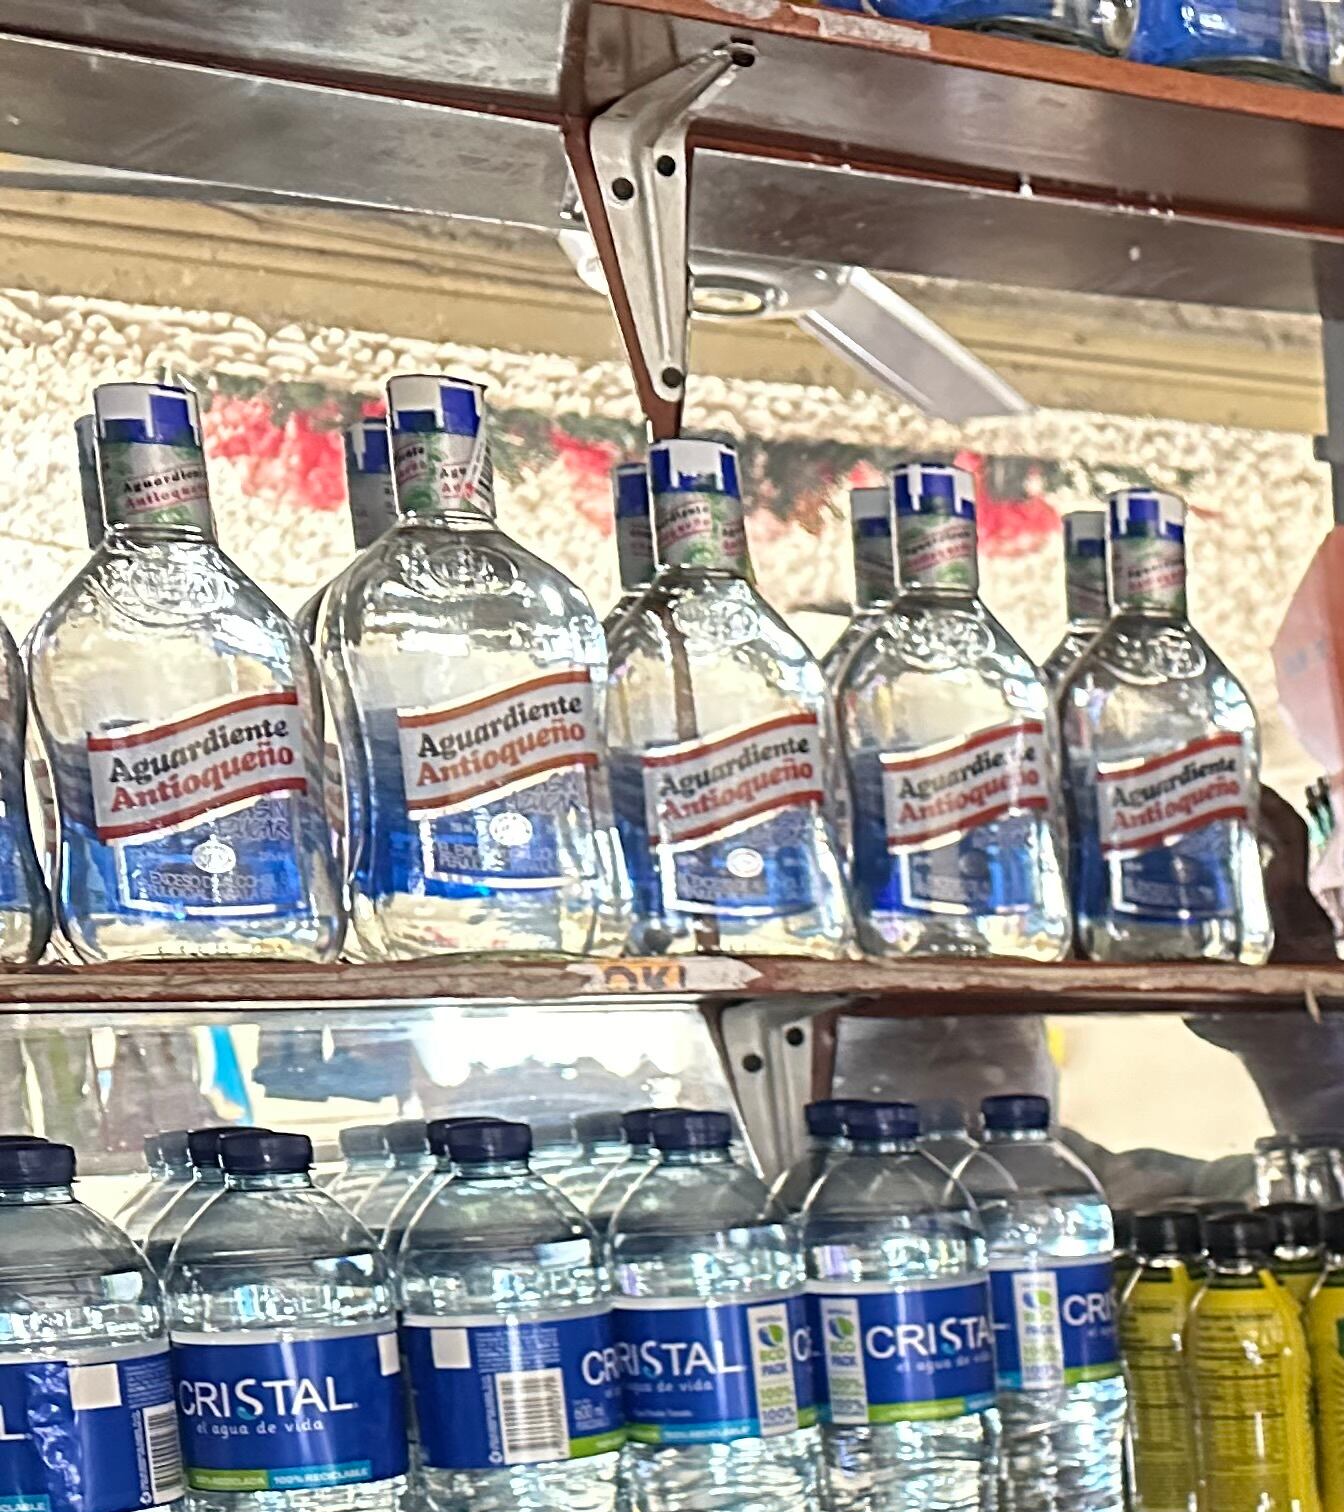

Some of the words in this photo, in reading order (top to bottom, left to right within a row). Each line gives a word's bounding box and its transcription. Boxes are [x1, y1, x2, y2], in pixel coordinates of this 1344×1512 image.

[107, 716, 290, 785] Aguardiente
[415, 718, 586, 788] Antioqueño
[418, 693, 583, 760] Aguardiente
[109, 743, 294, 812] Antioqueño
[658, 736, 811, 796] Aguardiente
[658, 757, 814, 821] Antioqueño
[1110, 756, 1237, 808] Aguardiente
[1110, 776, 1241, 830] Antioqueño
[620, 1339, 746, 1377] RISTAL
[865, 1315, 996, 1360] CRISTA
[178, 1374, 356, 1420] CRISTAL
[212, 1421, 249, 1439] agua
[256, 1419, 277, 1435] de
[283, 1418, 325, 1433] vida
